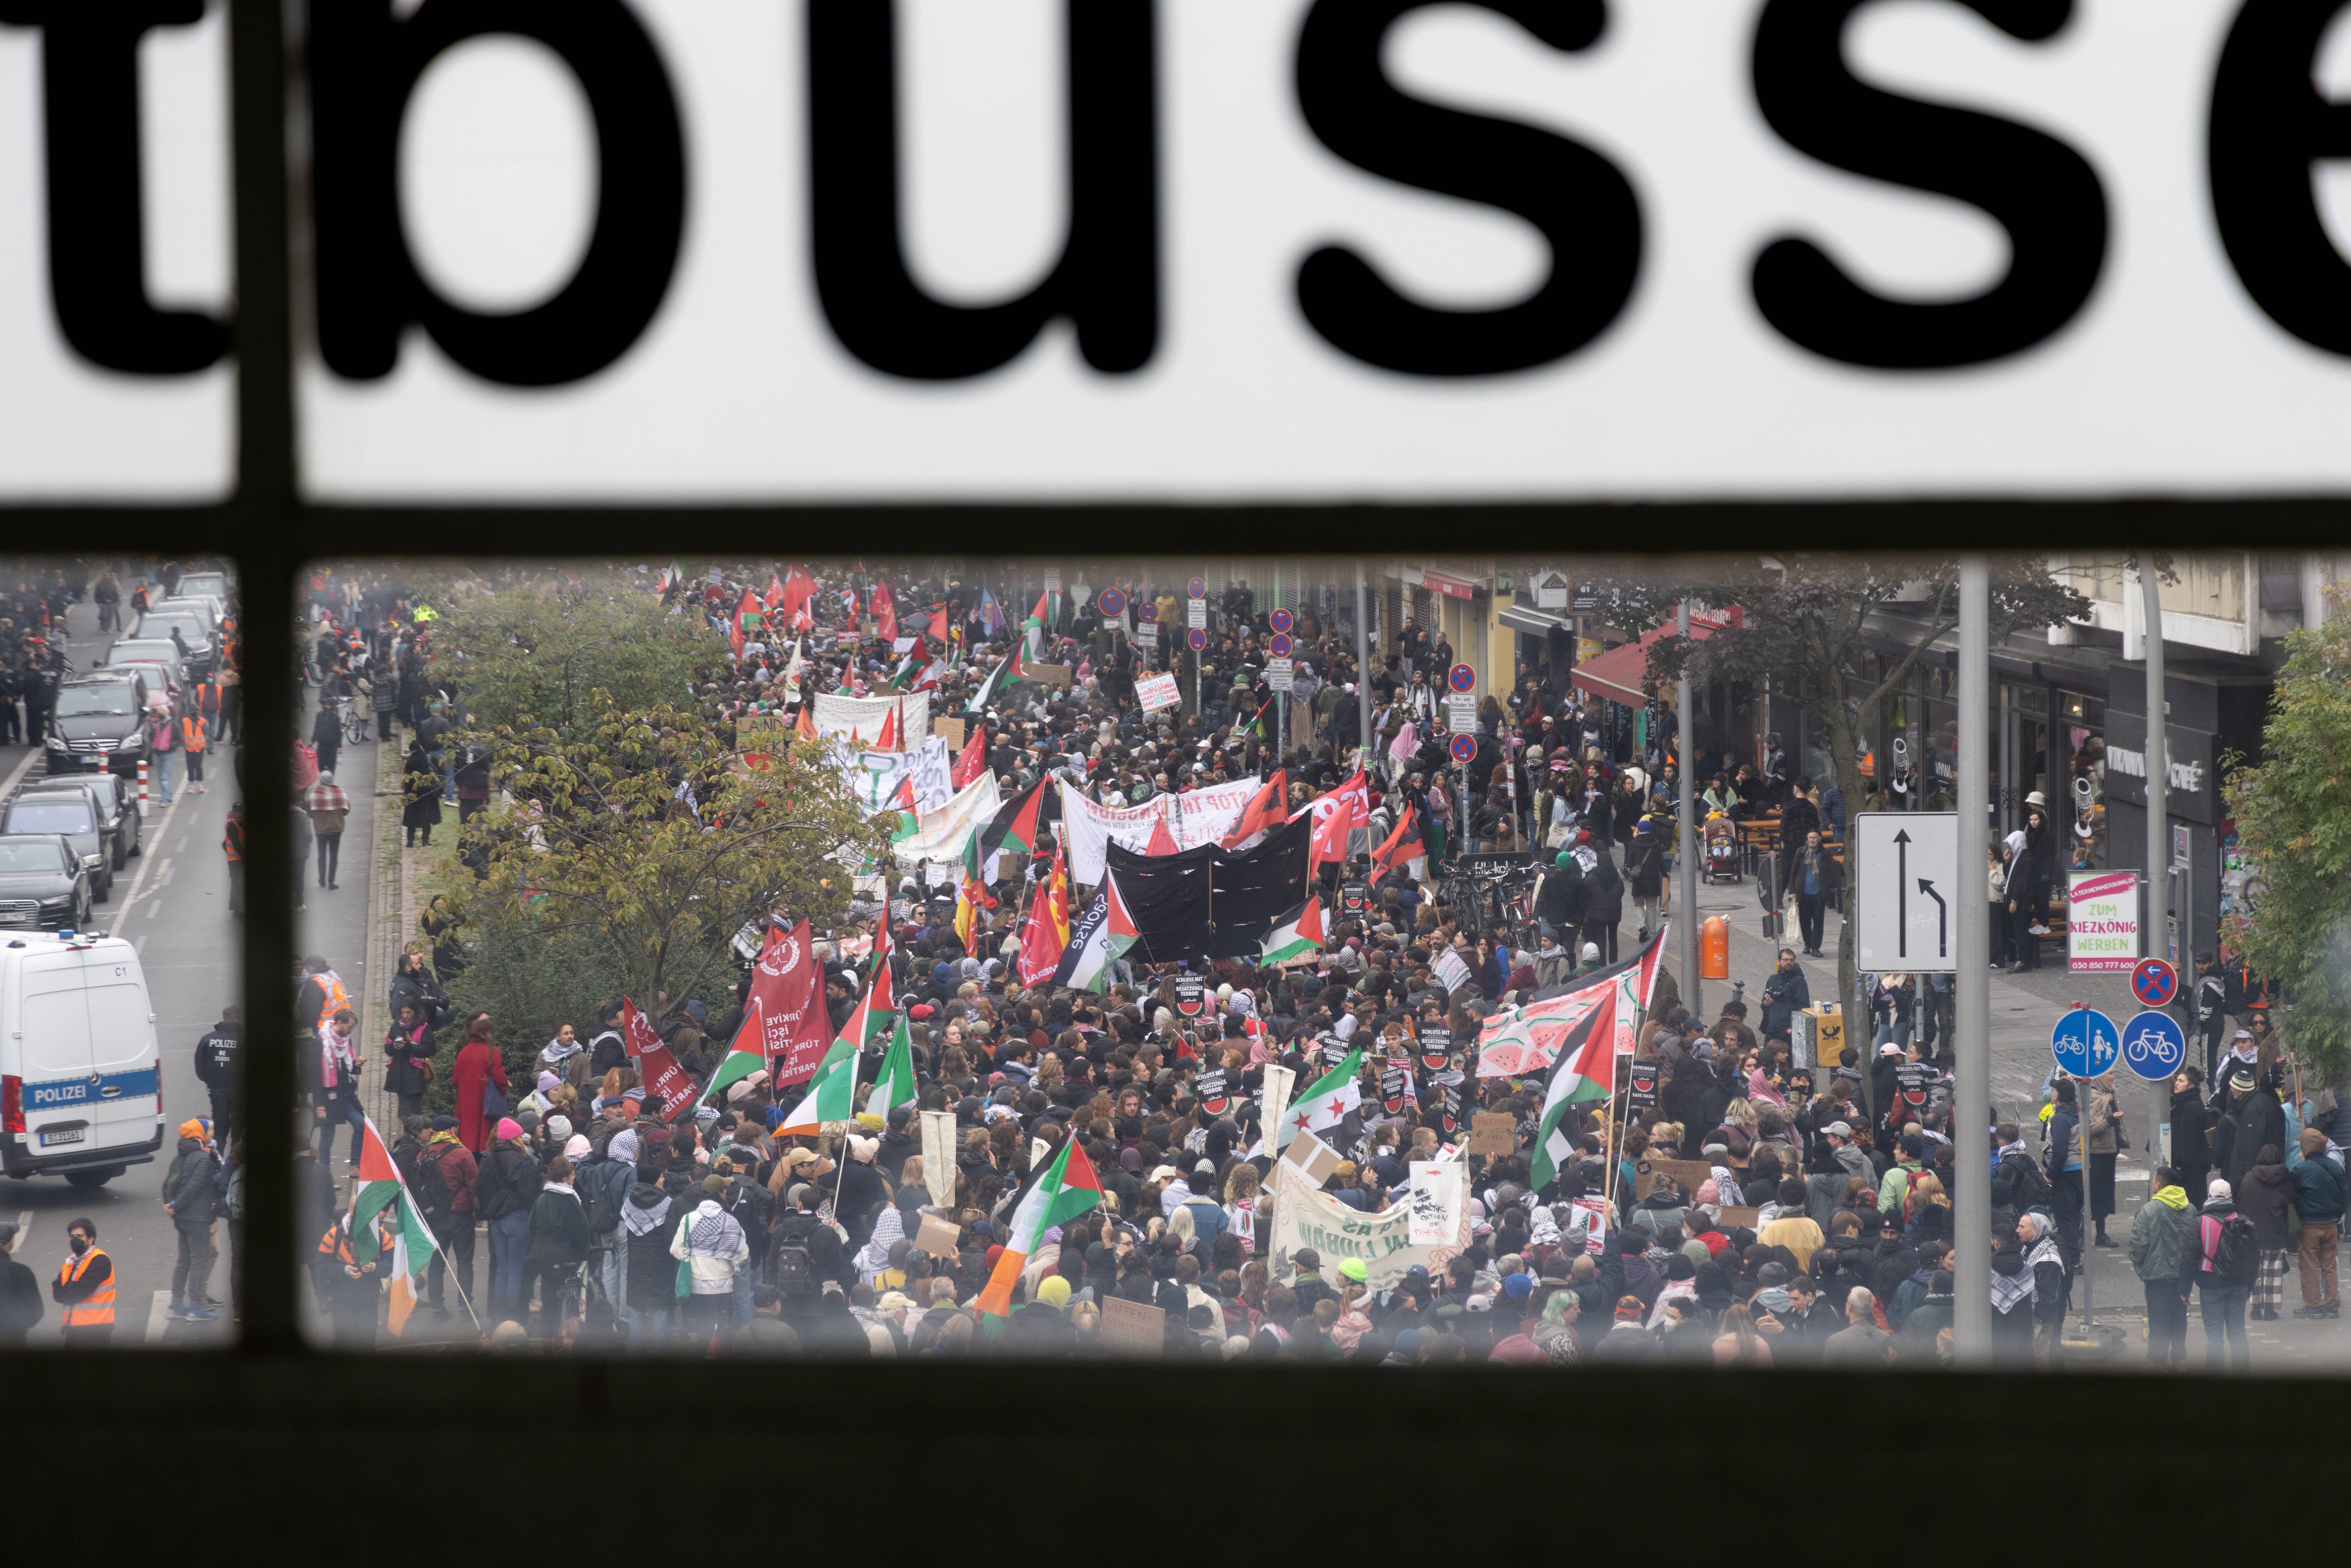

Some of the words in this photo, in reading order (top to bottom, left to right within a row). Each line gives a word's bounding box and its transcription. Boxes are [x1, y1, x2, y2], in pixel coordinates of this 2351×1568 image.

[739, 718, 782, 732] LAND
[1475, 860, 1508, 875] fritz-kol
[2070, 878, 2135, 898] LATERNENWERBUNG.DE
[2088, 904, 2117, 916] ZUM
[2070, 919, 2137, 934] KIEZKÖNIG
[2078, 939, 2129, 951] WERBEN
[115, 967, 127, 976] C1
[209, 1039, 237, 1048] POLIZEI
[1324, 1037, 1340, 1047] SCHLUSS
[1323, 1048, 1348, 1058] BESATZUNGS
[1326, 1054, 1343, 1063] TERROR!
[1195, 1072, 1215, 1081] SCHLUSS
[1382, 1070, 1396, 1079] SCHLUSS
[1197, 1079, 1227, 1091] BESATZUNGS
[1383, 1079, 1404, 1089] BESATZUNGS
[1386, 1085, 1401, 1094] TERROR!
[35, 1085, 87, 1103] POLIZEI
[1203, 1086, 1223, 1095] TERROR!
[1447, 1087, 1457, 1099] SCHLUSS
[1446, 1096, 1460, 1110] BESATZUNGS
[49, 1134, 54, 1143] B
[59, 1131, 80, 1141] 31161
[1415, 1188, 1429, 1198] RE:
[1106, 1302, 1154, 1321] WAFFEN-
[1106, 1316, 1157, 1338] STILLSTAND
